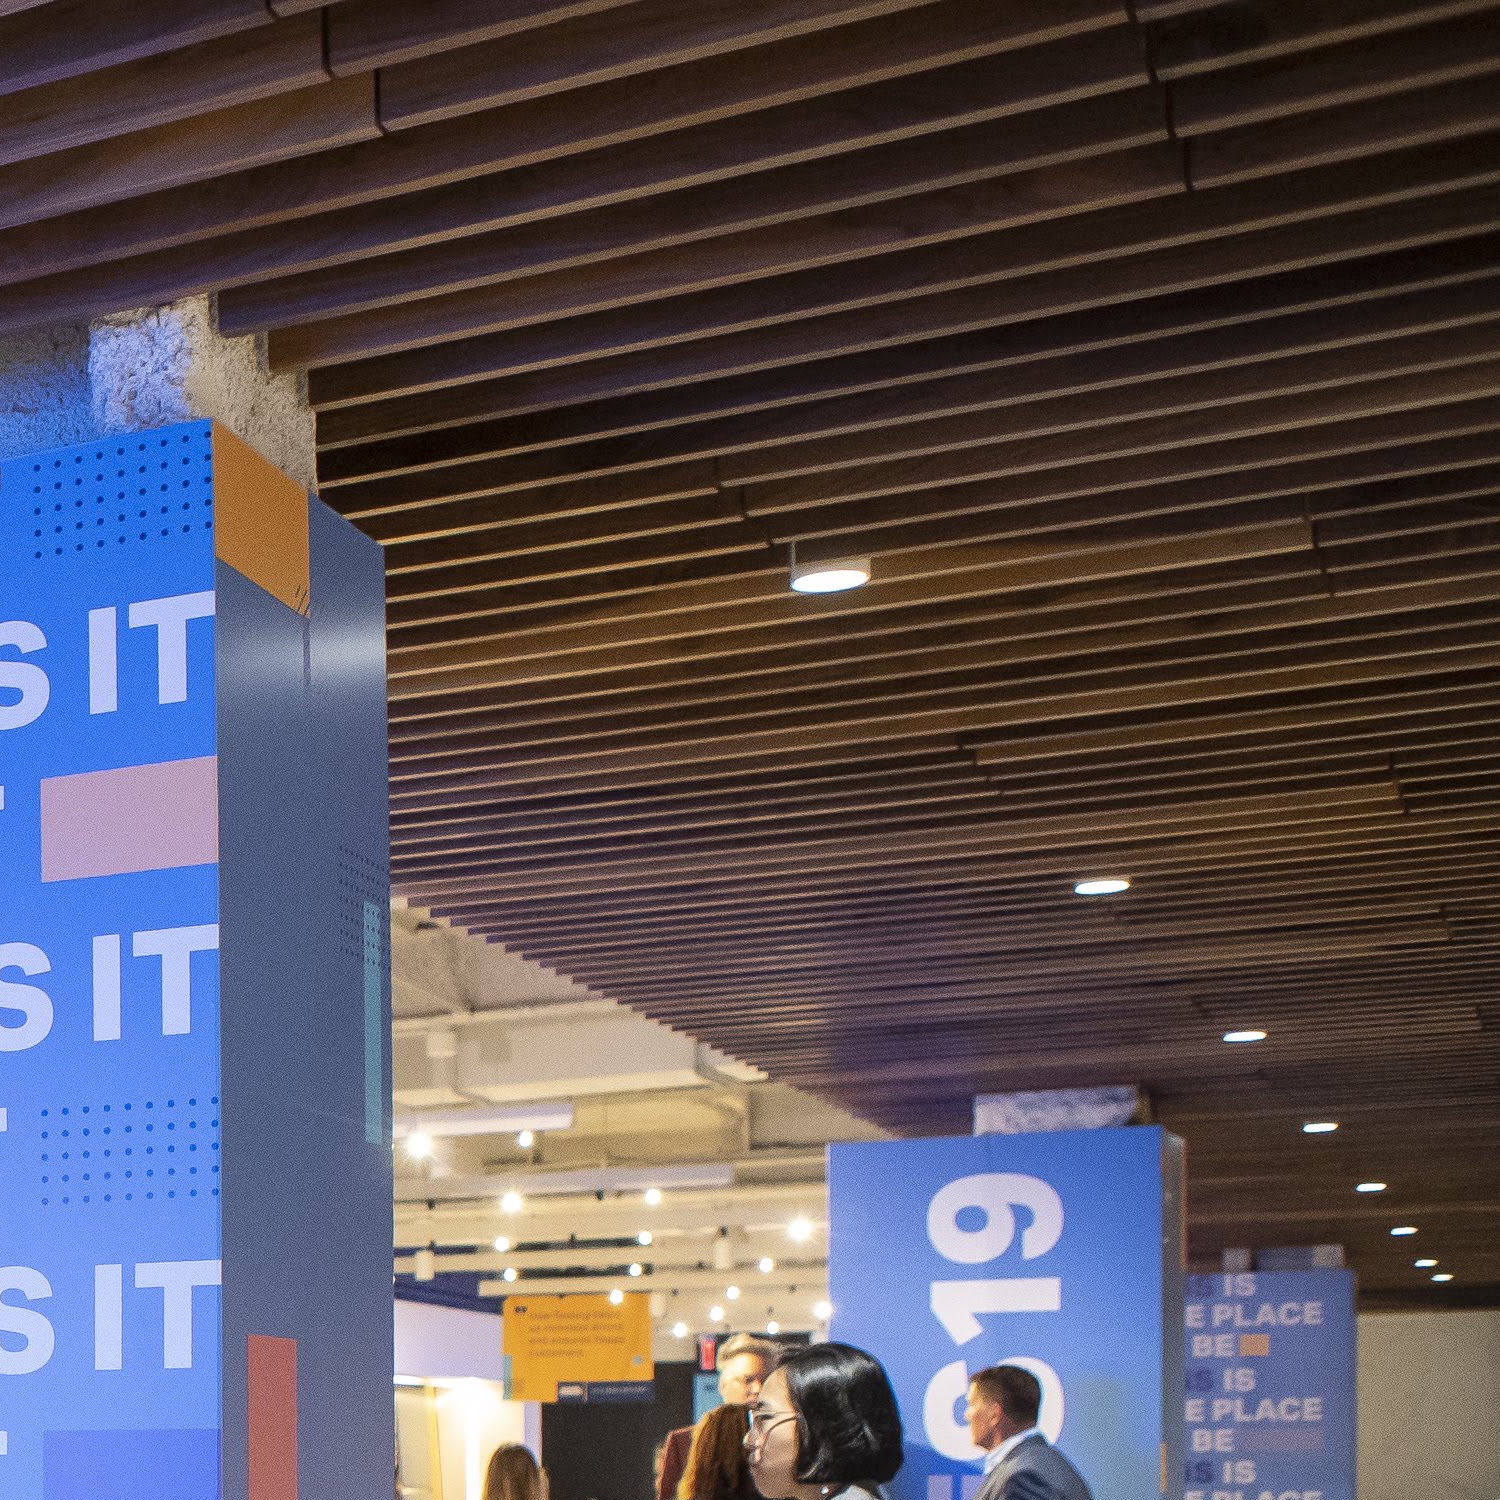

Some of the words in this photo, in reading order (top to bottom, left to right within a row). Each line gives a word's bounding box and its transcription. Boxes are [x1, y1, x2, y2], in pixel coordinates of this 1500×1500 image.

[88, 591, 215, 714] IT
[92, 924, 218, 1042] IT
[1223, 1273, 1256, 1296] IS
[94, 1260, 221, 1370] IT
[1212, 1303, 1323, 1327] PLACE
[1192, 1334, 1235, 1357] BE
[1223, 1368, 1256, 1392] IS
[1212, 1398, 1323, 1422] PLACE
[1192, 1429, 1235, 1452] BE
[1223, 1460, 1256, 1484] IS
